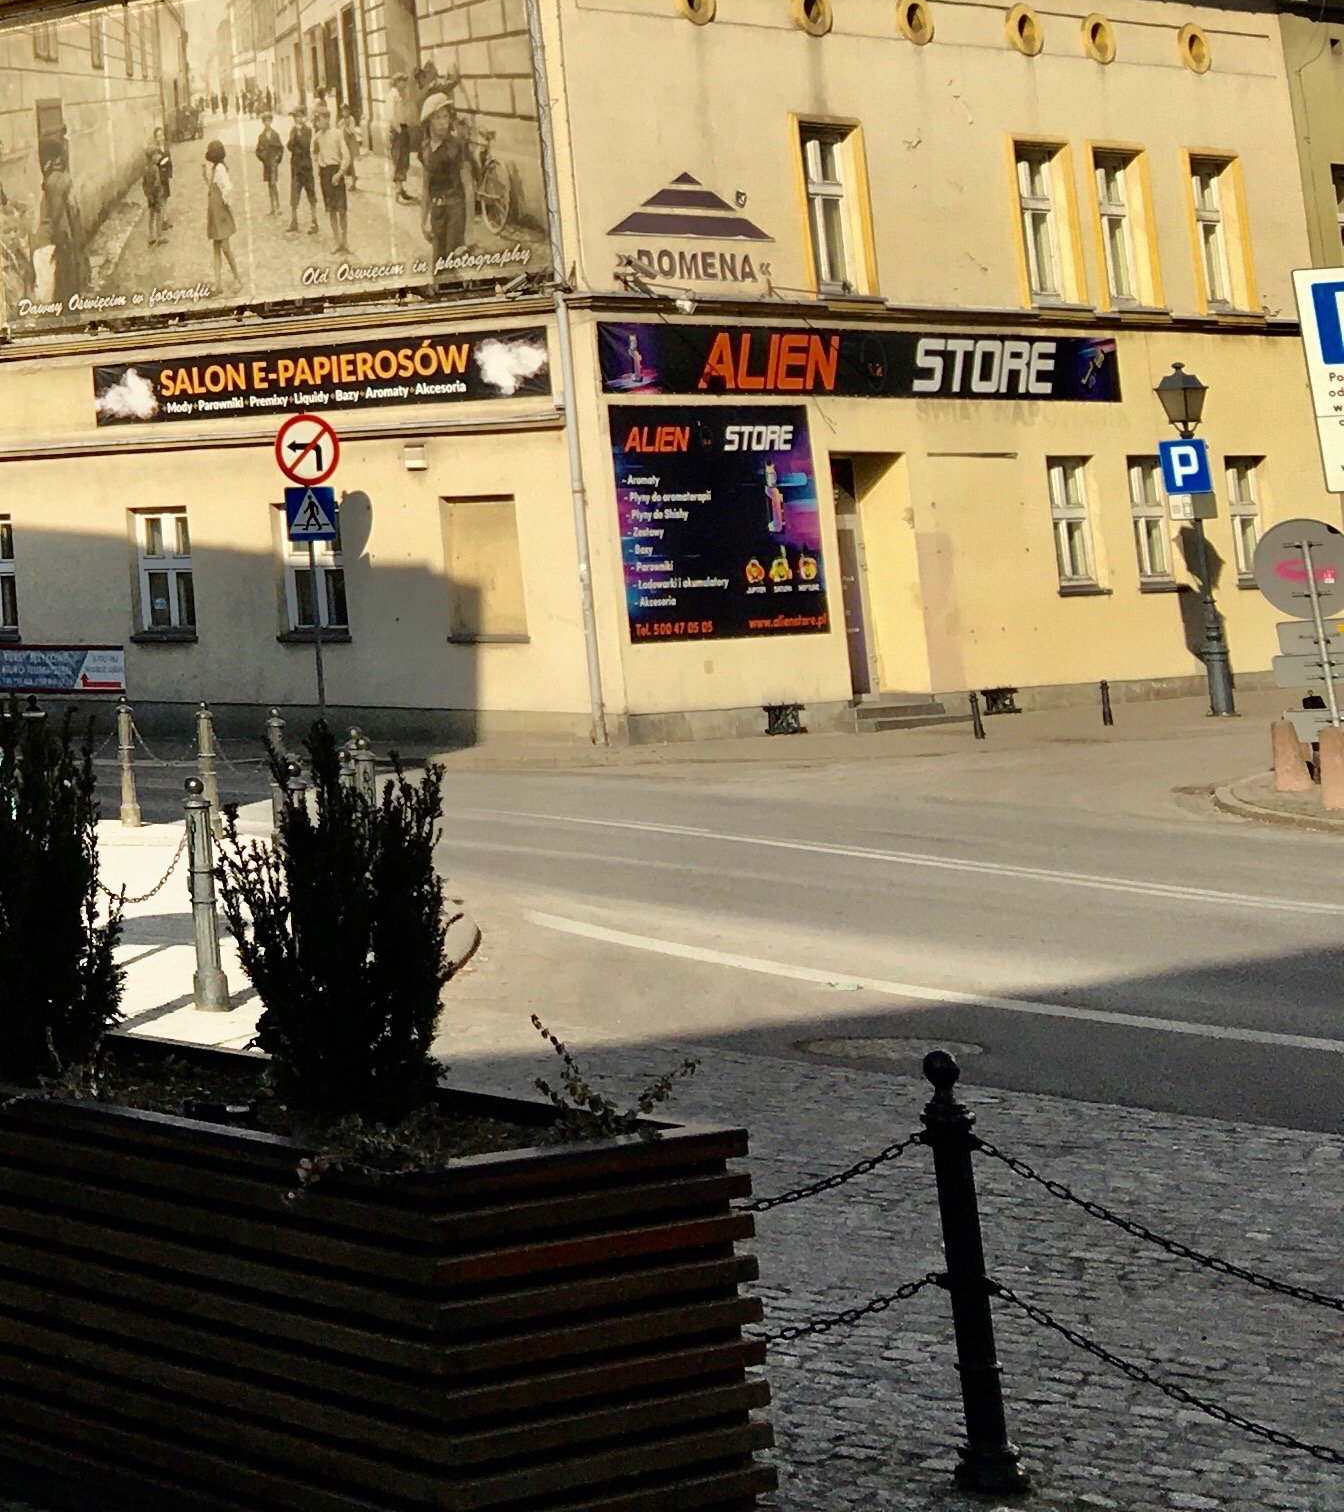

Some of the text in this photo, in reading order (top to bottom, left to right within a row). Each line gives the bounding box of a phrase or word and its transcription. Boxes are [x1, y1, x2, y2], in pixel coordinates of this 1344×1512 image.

[302, 264, 330, 287] Old
[412, 257, 429, 275] in
[433, 244, 534, 275] photography
[636, 248, 759, 282] DOMENA
[18, 284, 212, 318] Dawny Oświęcim w fotografii
[159, 339, 471, 398] SALON E-PAPIEROSÓW
[697, 331, 1058, 395] ALIEN STORE
[167, 380, 468, 415] Mody Parowniki Premixy Liquidy Bazy Aromaty Akcesoria
[624, 424, 795, 453] ALIEN STORE
[1169, 445, 1200, 488] P
